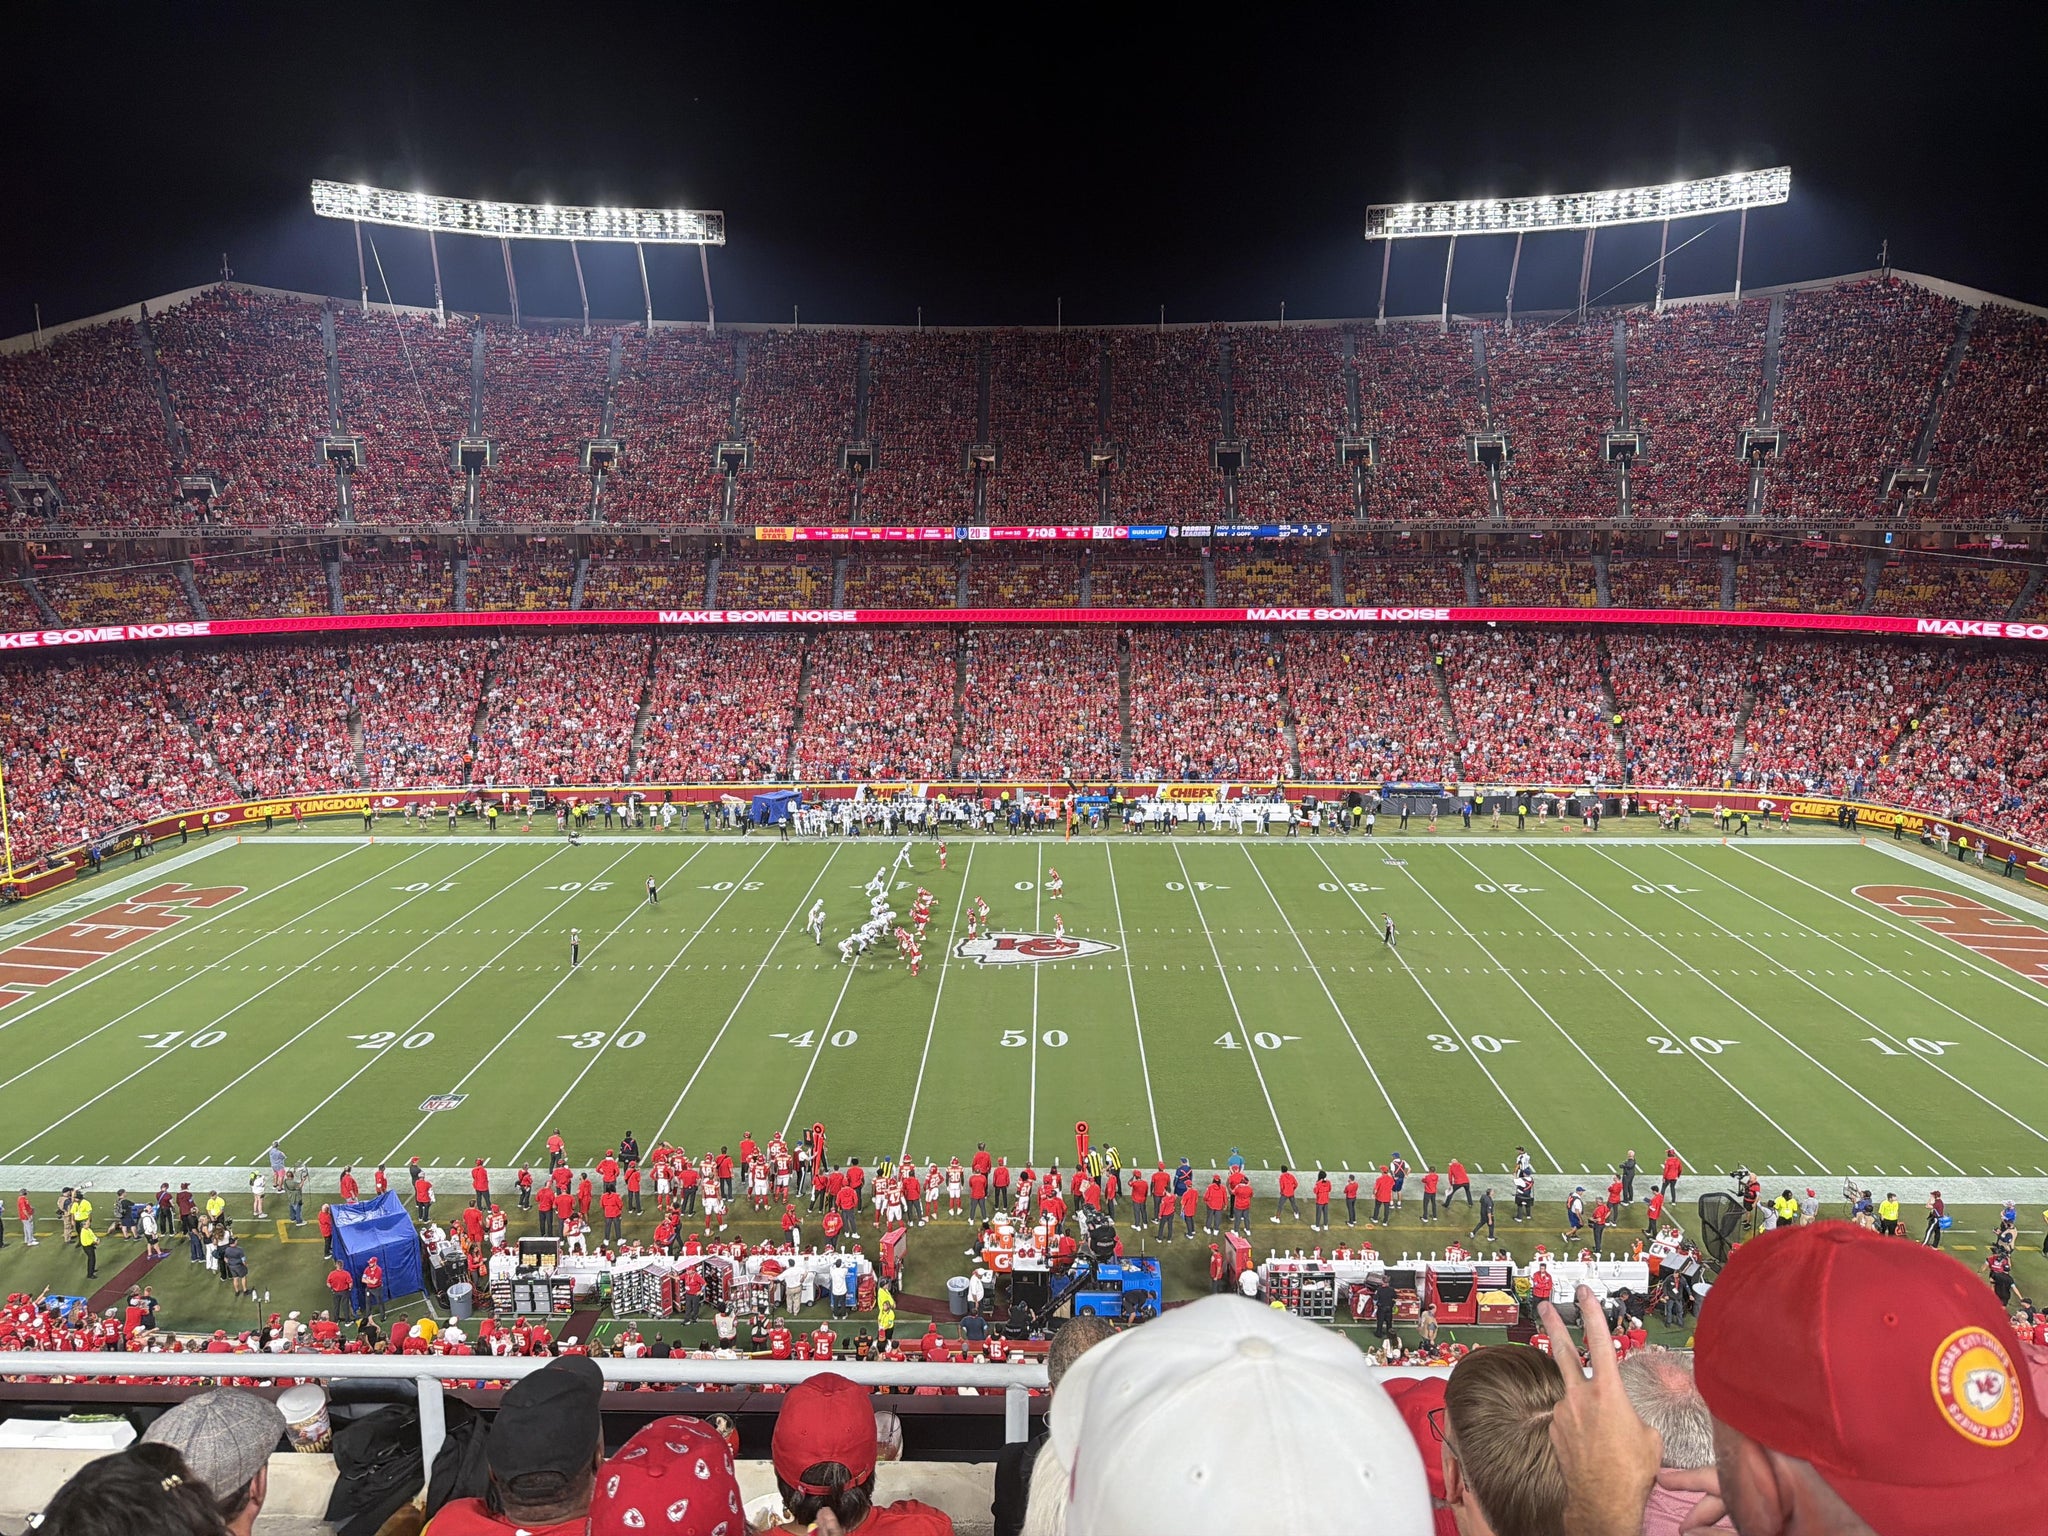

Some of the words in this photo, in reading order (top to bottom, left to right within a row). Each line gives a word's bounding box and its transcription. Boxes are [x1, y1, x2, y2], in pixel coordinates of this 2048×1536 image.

[1772, 522, 1855, 530] SCHOTTENHEIMER
[1966, 523, 2009, 531] SHIELDS
[29, 531, 80, 540] HEADRICK
[201, 529, 252, 537] McCLINTON
[970, 529, 980, 538] 20
[1027, 528, 1056, 538] 7:08
[1102, 528, 1112, 537] 24
[659, 611, 723, 622] MAKE
[727, 611, 789, 622] SOME
[793, 611, 857, 622] NOISE
[1247, 609, 1310, 620] MAKE
[1314, 609, 1378, 620] SOME
[1381, 609, 1449, 620] NOISE
[1917, 619, 2002, 636] MAKE
[0, 633, 38, 648] KE
[42, 627, 124, 644] SOME
[128, 622, 210, 640] NOISE
[1170, 788, 1214, 798] CHIEFS
[243, 803, 293, 818] CHEFS
[1848, 808, 1923, 829] INGDOM
[993, 938, 1080, 957] KC
[657, 1168, 663, 1177] 5
[950, 1172, 961, 1182] 30
[929, 1178, 941, 1188] 22
[889, 1194, 900, 1204] 47
[492, 1220, 504, 1230] 66
[994, 1253, 1009, 1269] G
[106, 1328, 115, 1336] 15
[54, 1338, 61, 1351] 7
[772, 1341, 784, 1350] 95
[816, 1343, 829, 1354] 15
[800, 1351, 804, 1360] 1
[989, 1344, 1002, 1357] 15
[1939, 1343, 1962, 1395] KANSAS
